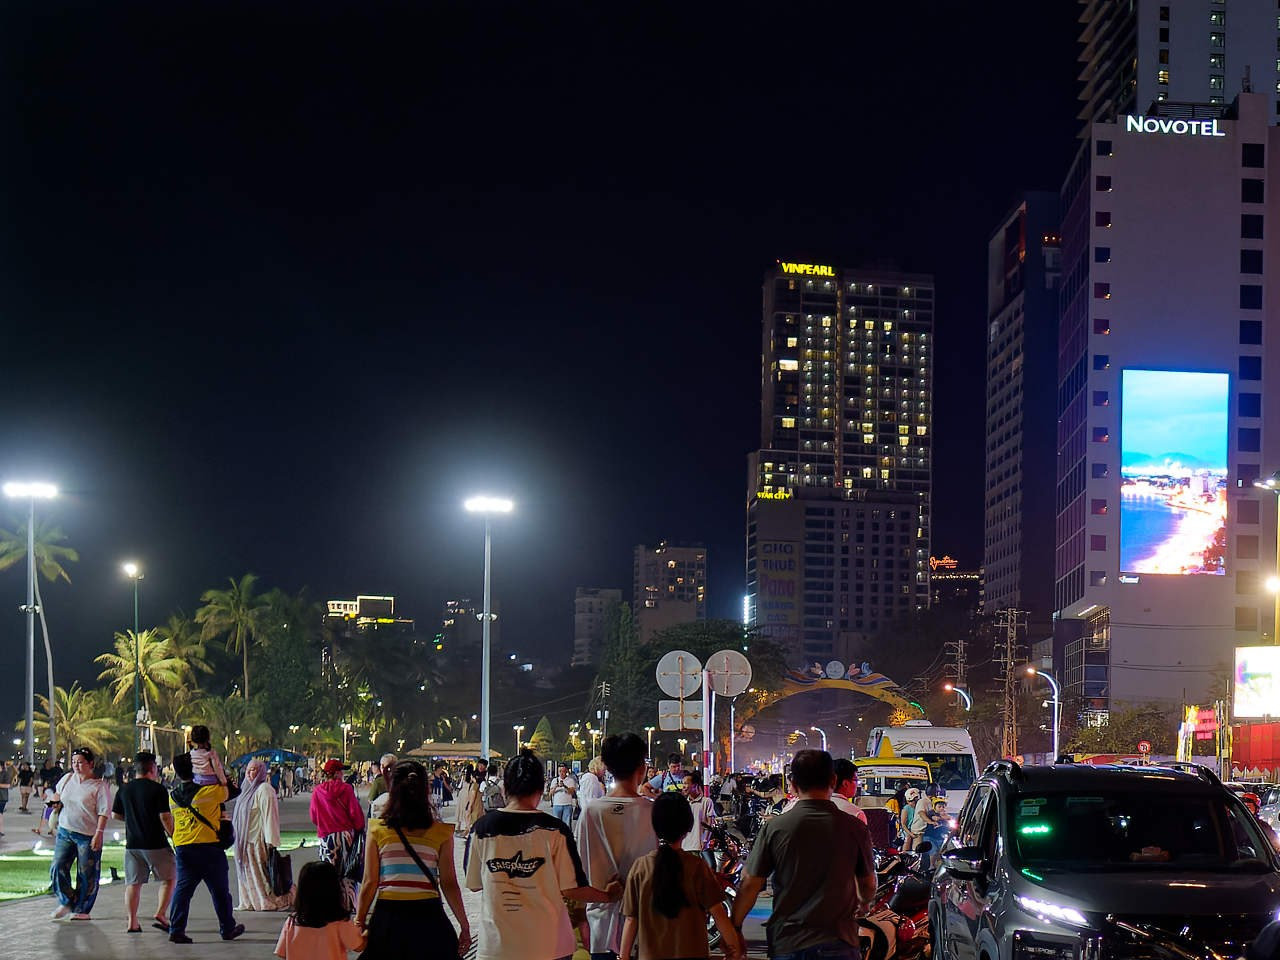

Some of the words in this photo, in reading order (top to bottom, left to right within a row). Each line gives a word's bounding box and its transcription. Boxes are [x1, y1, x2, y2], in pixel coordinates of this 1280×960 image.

[1127, 115, 1226, 136] NOVOTEL
[782, 262, 835, 277] VINPEARL
[919, 741, 940, 750] VIP
